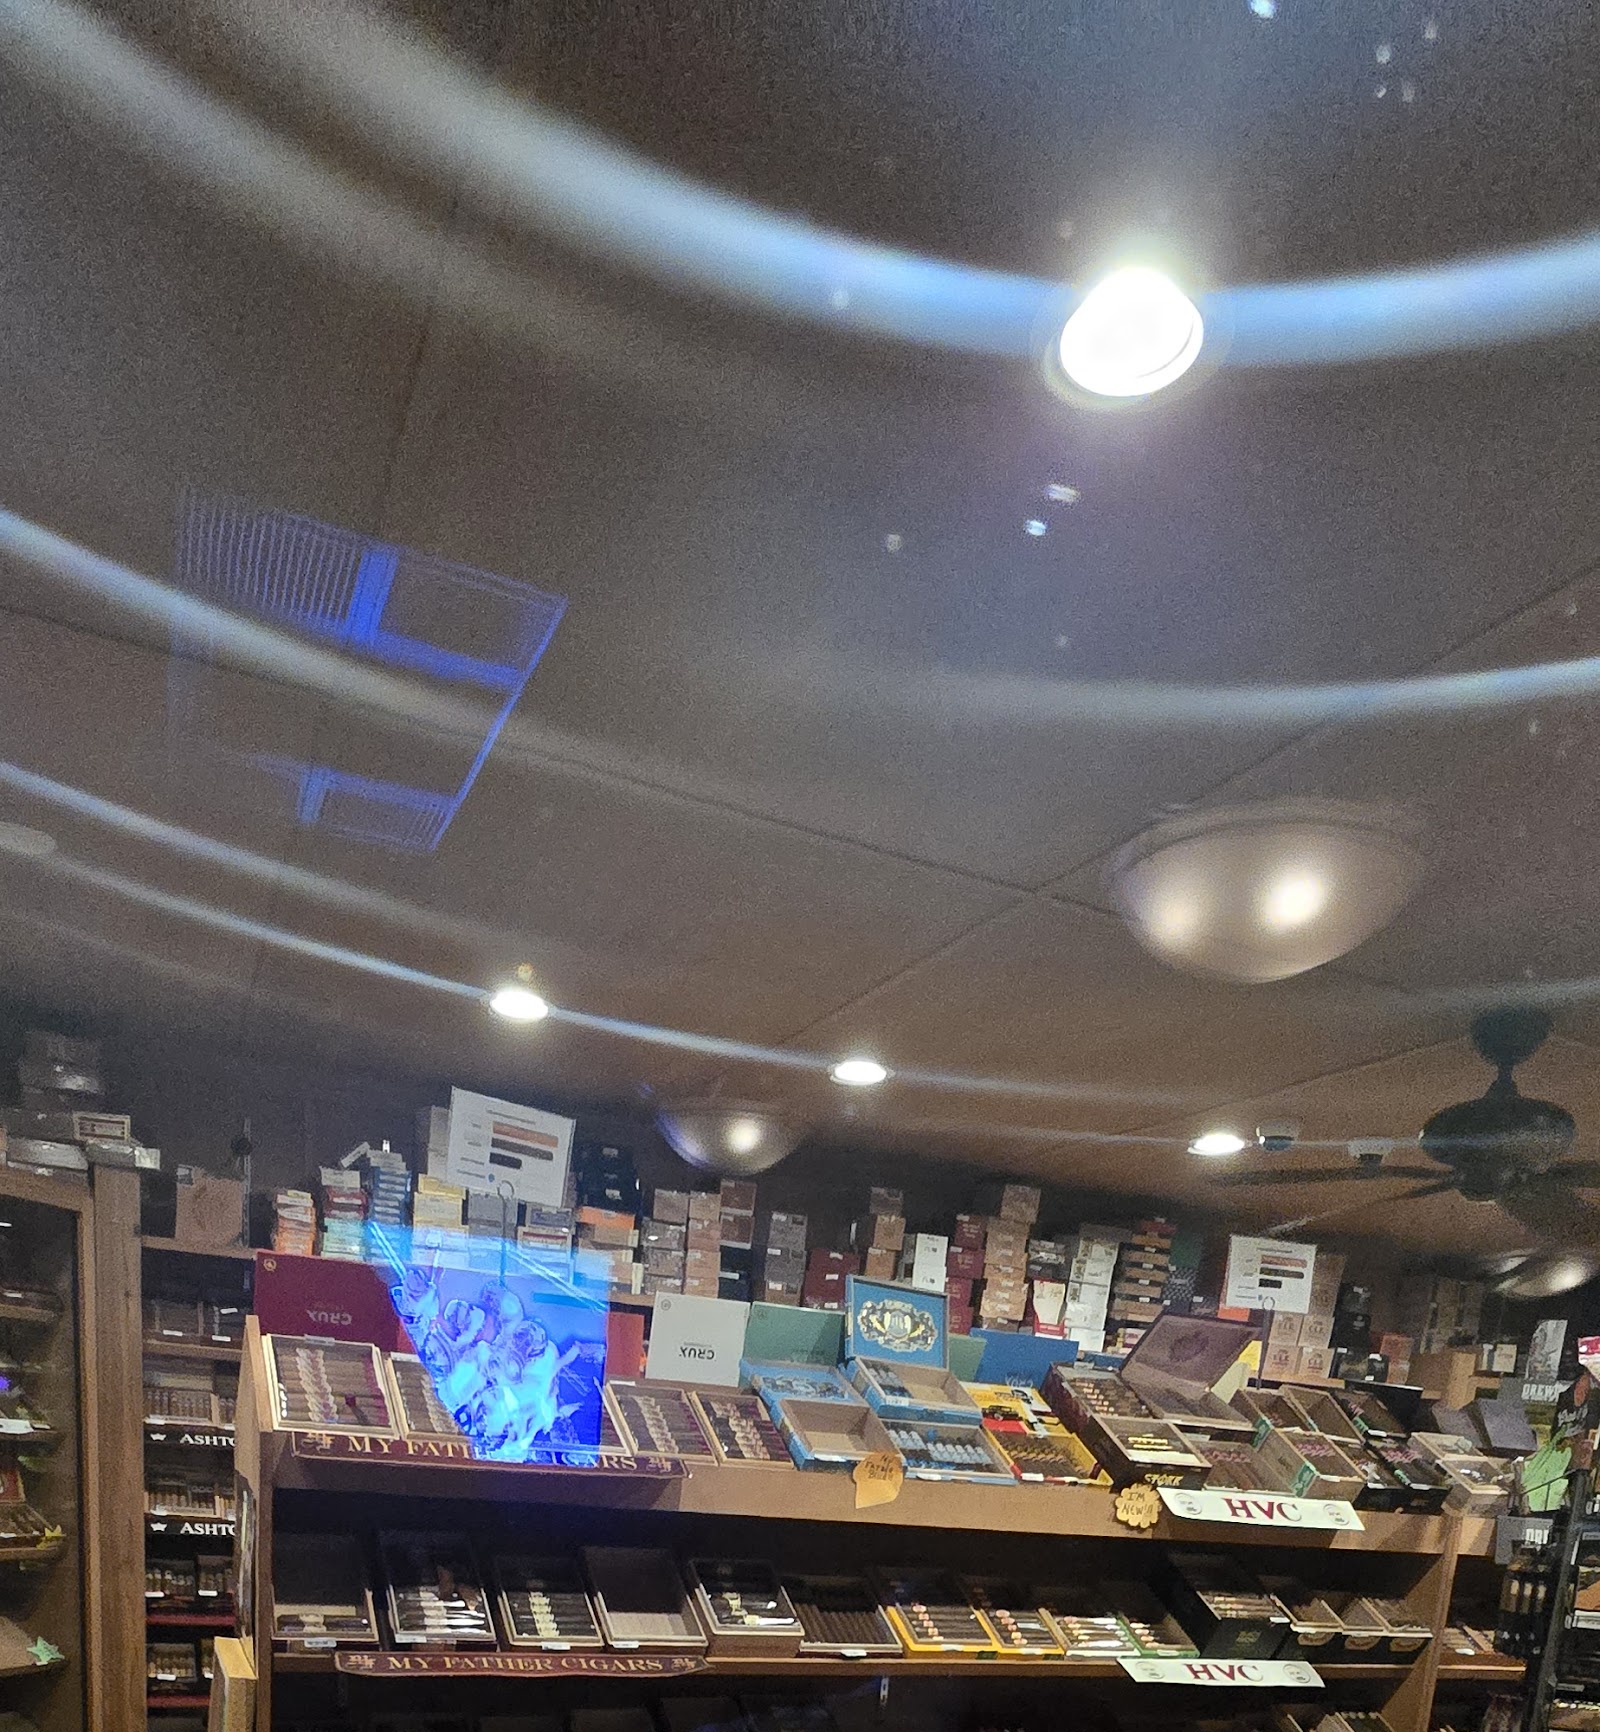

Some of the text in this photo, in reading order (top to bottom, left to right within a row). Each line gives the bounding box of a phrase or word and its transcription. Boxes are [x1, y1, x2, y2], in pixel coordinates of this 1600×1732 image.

[306, 1309, 353, 1326] CRUX
[679, 1346, 715, 1360] CRUX
[348, 1436, 393, 1454] MY
[1223, 1498, 1302, 1522] HVC
[388, 1656, 433, 1670] MY
[444, 1656, 553, 1671] FATHER
[561, 1657, 663, 1671] CIGARS
[1184, 1663, 1264, 1682] HVC
